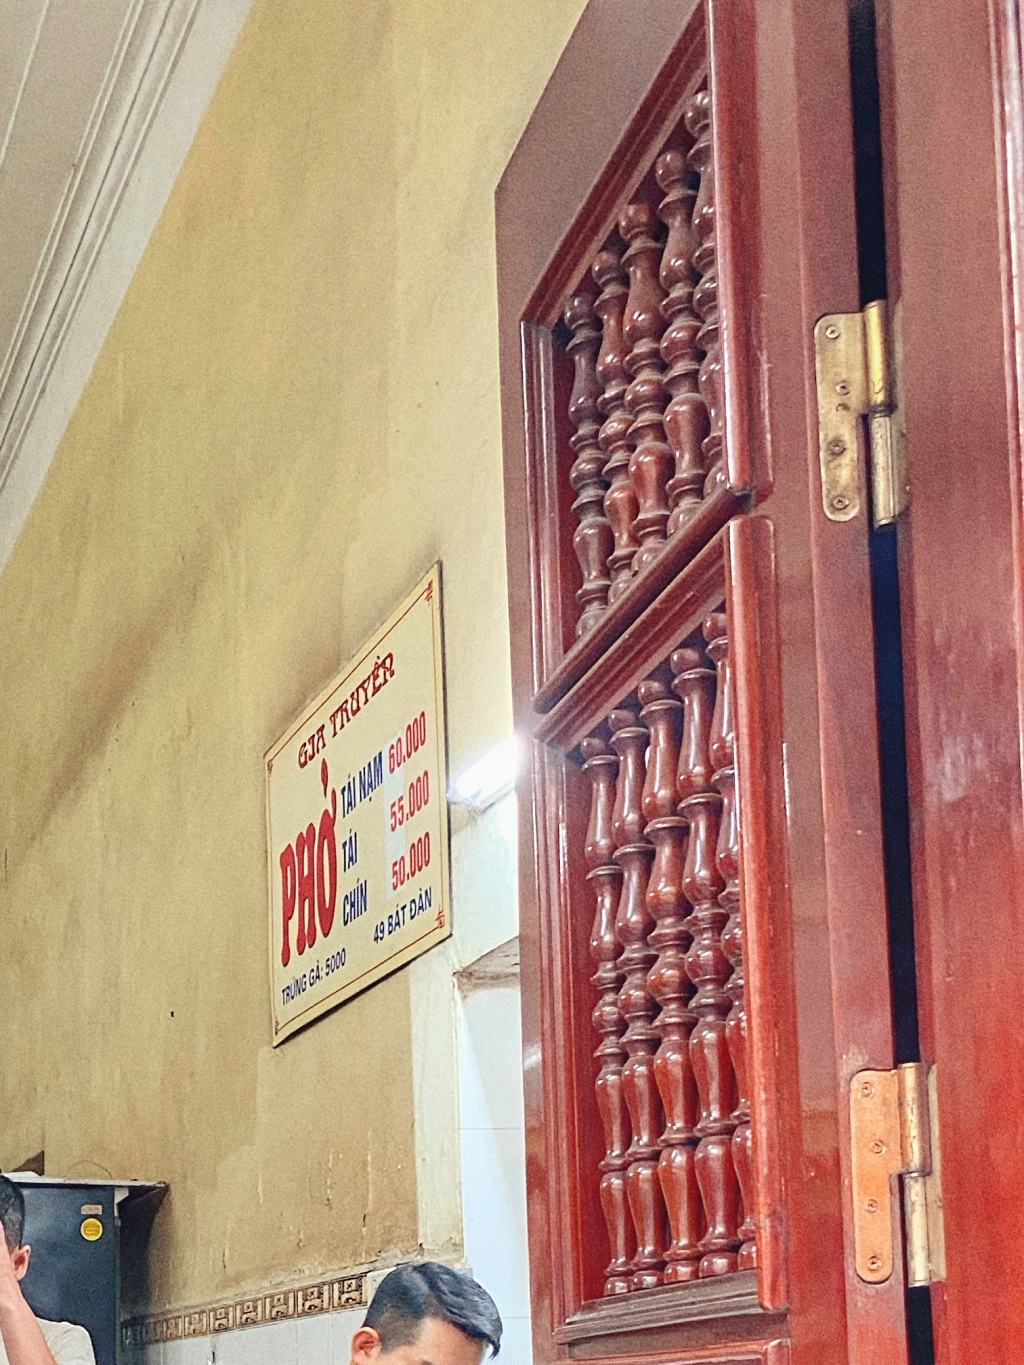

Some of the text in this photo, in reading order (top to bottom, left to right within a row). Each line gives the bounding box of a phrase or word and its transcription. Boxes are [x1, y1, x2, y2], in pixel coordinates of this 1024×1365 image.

[329, 652, 395, 738] TRUYỀN
[341, 710, 426, 819] TÁI NẠM 60.000
[279, 757, 337, 968] PHỞ
[342, 769, 429, 873] TÁI 55.000
[343, 831, 431, 927] CHÍN 50.000
[373, 886, 432, 944] 49 BÁT ĐÀN
[325, 947, 347, 976] 5000
